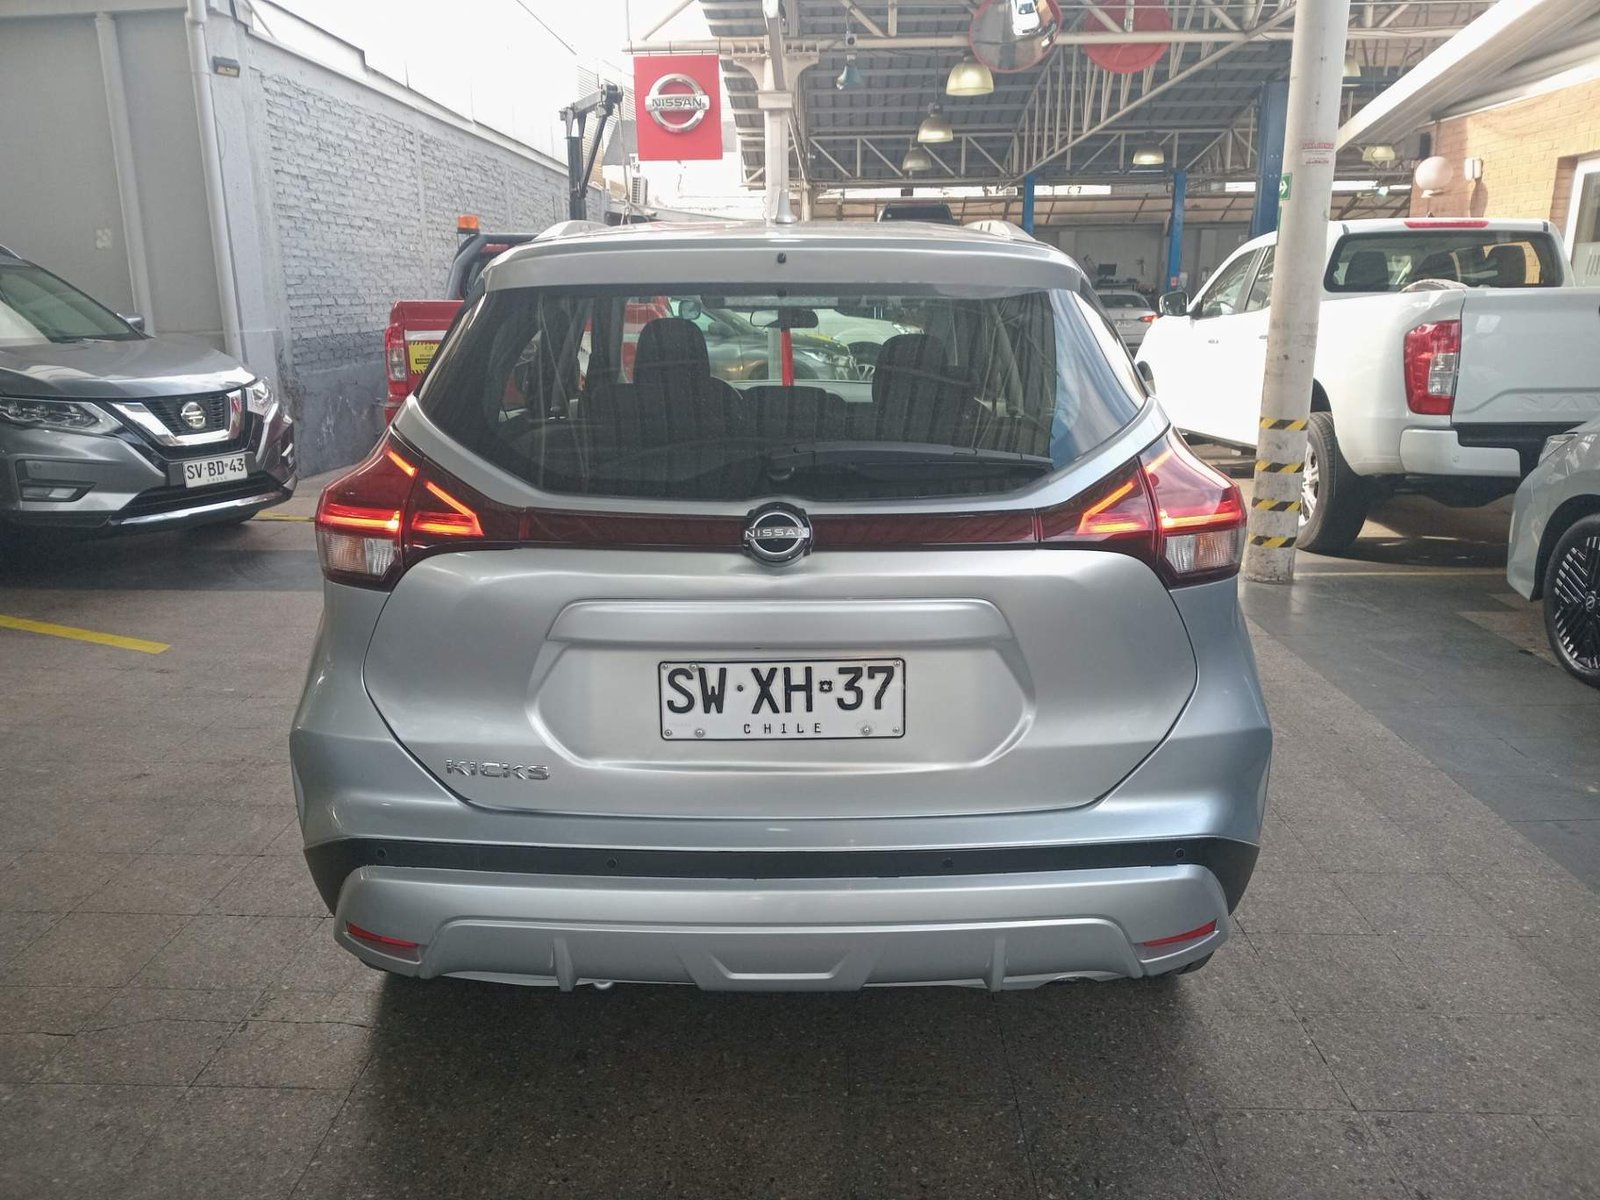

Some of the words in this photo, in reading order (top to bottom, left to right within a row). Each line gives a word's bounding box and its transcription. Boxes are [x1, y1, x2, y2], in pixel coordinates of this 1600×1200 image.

[652, 97, 702, 108] NISSAN
[744, 528, 810, 539] NISSAN
[743, 722, 822, 735] CHILE
[445, 759, 550, 780] KICKS
